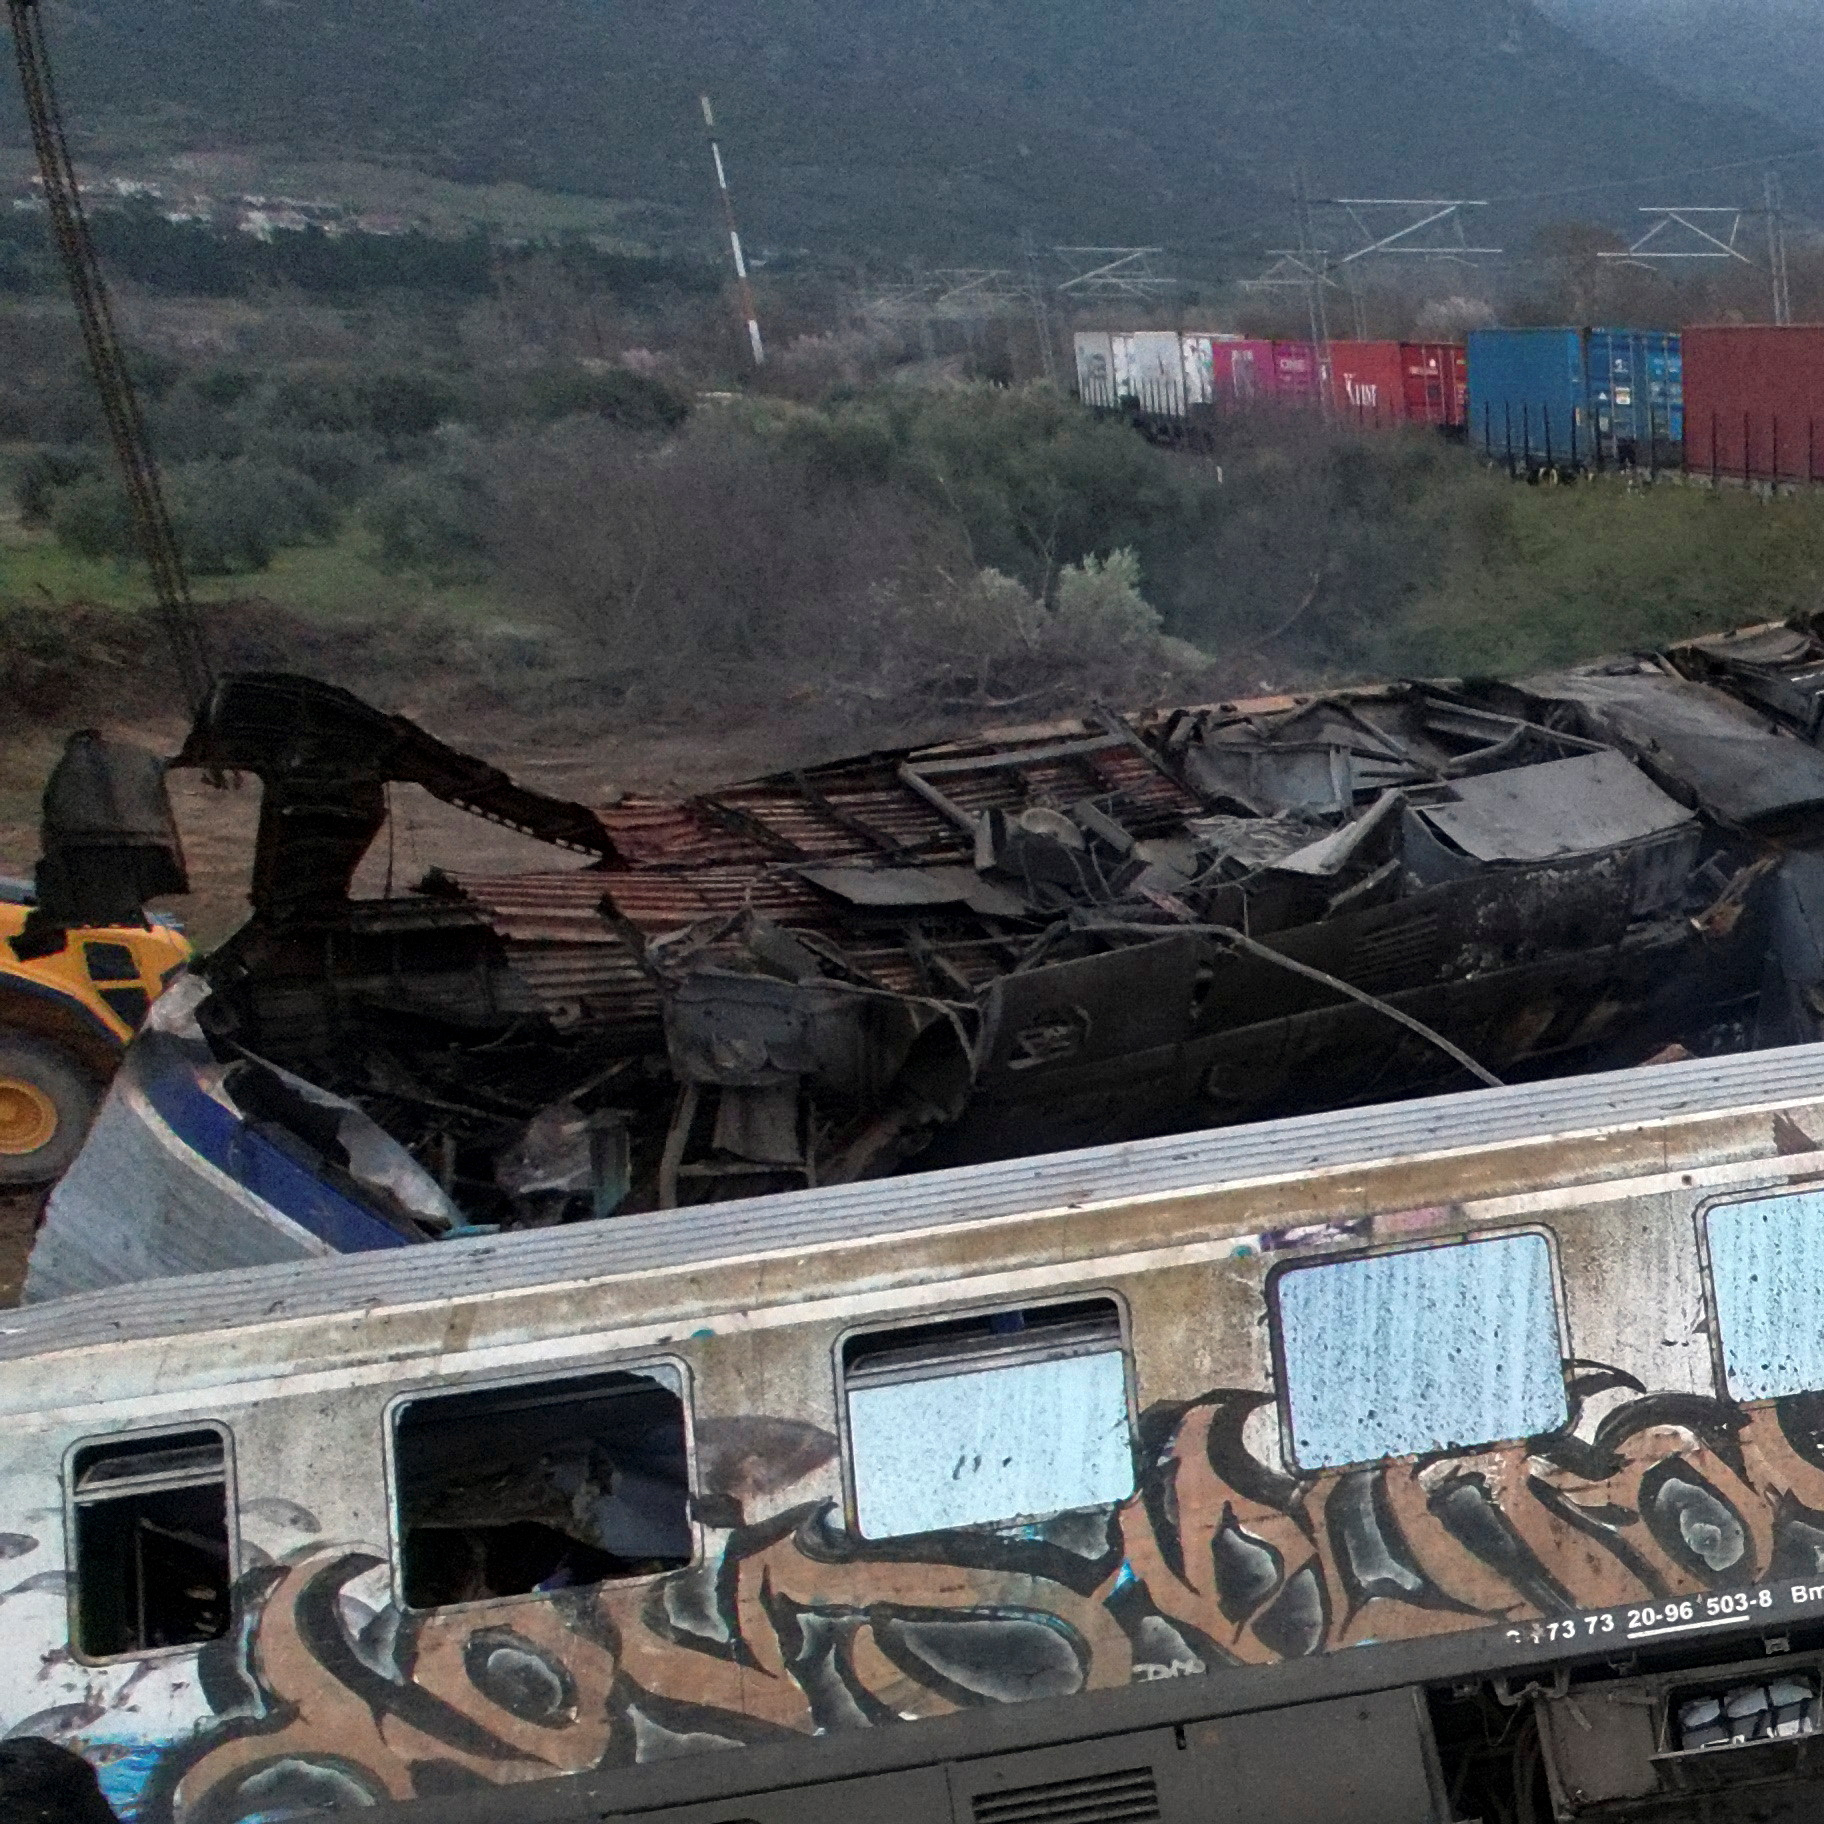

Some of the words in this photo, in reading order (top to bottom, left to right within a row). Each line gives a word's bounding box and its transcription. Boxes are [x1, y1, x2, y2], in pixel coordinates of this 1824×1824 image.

[1547, 1620, 1576, 1642] 73
[1584, 1613, 1615, 1635] 73
[1627, 1601, 1694, 1629] 20-96
[1706, 1589, 1773, 1617] 503-8
